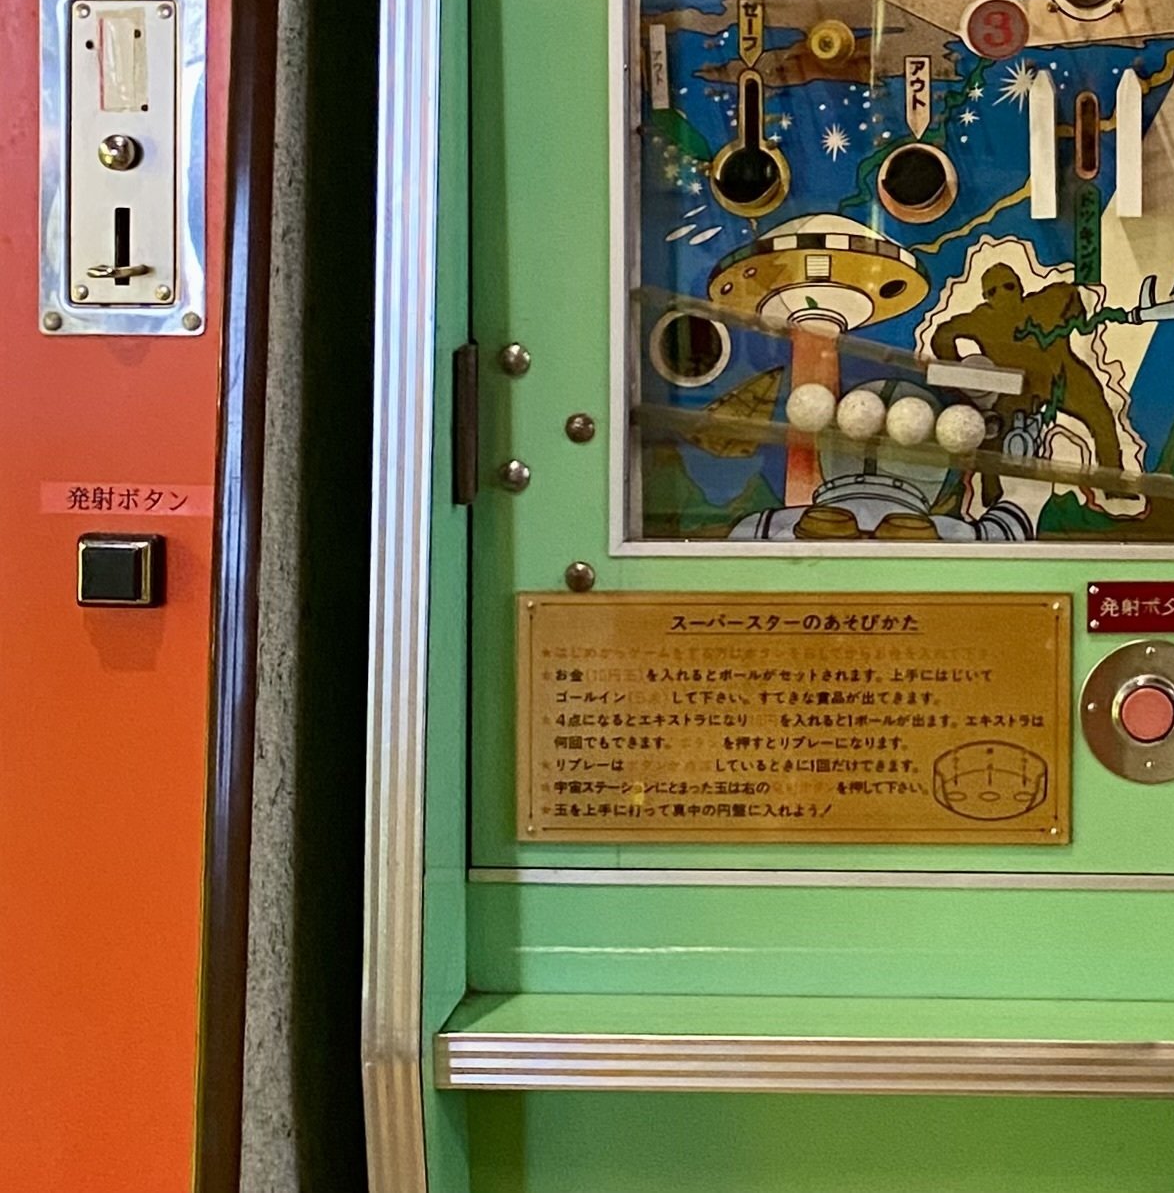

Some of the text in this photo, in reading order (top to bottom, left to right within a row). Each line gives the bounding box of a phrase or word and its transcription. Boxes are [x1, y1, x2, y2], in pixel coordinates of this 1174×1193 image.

[742, 2, 758, 52] セーフ
[982, 10, 1013, 48] 3
[909, 60, 927, 109] アウト
[67, 486, 189, 512] 発射ボタン
[671, 614, 919, 632] スーパースターのあそびかた
[555, 668, 584, 683] お金
[555, 691, 627, 705] ゴールイン
[555, 758, 625, 773] リプレーは
